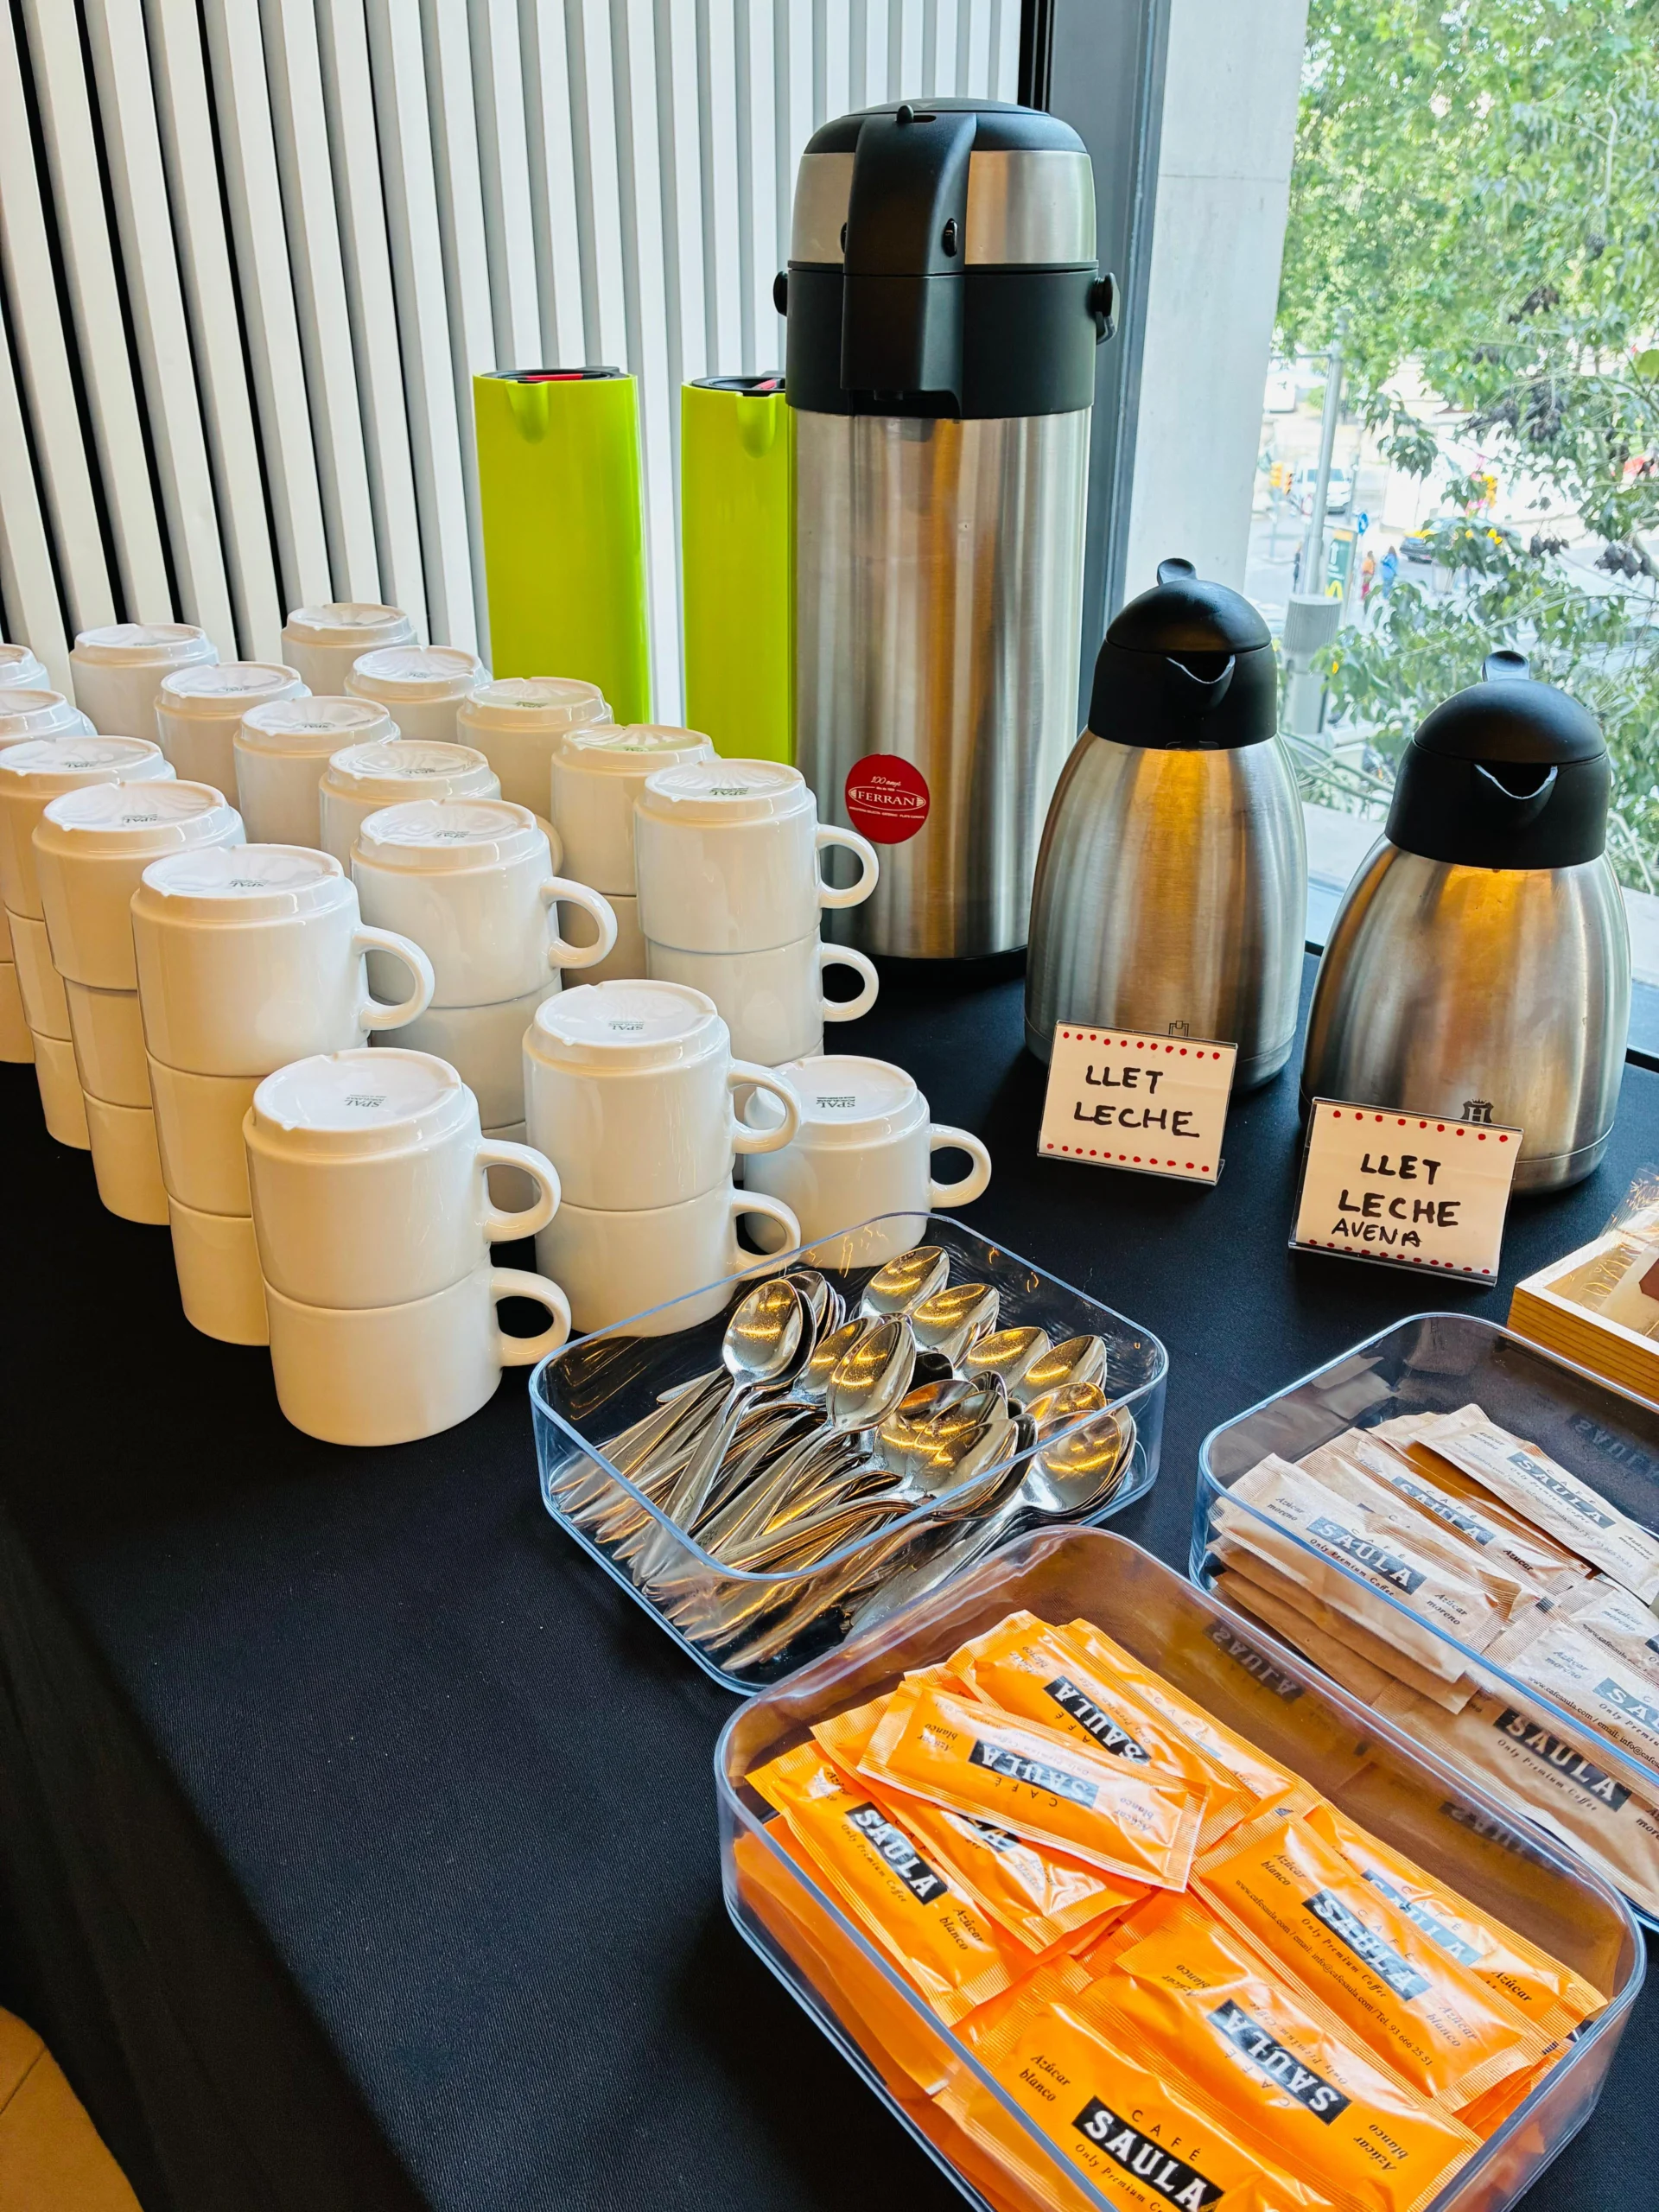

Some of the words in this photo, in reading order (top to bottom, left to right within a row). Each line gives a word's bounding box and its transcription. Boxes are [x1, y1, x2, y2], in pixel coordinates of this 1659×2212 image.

[858, 791, 914, 805] FERRAN
[1085, 1065, 1163, 1094] LLET
[1074, 1102, 1200, 1138] LECHE
[1360, 1154, 1441, 1185] LLET
[1338, 1190, 1460, 1227] LECHE
[1332, 1218, 1422, 1247] AVENA
[1275, 1497, 1305, 1514] Azúcar
[1517, 1459, 1604, 1523] SAULA
[1267, 1503, 1298, 1522] moreno
[1309, 1538, 1329, 1553] Only
[1332, 1550, 1367, 1578] Premium
[1370, 1577, 1395, 1597] Coffee
[1319, 1523, 1413, 1586] SAULA
[1426, 1599, 1461, 1625] moreno
[1434, 1592, 1468, 1617] Azúcar
[1055, 1681, 1143, 1761] SAULA
[1529, 1675, 1593, 1720] www.cafesaula.com
[1599, 1720, 1619, 1739] email:
[1599, 1703, 1622, 1720] Only
[925, 1722, 958, 1741] blanco
[981, 1745, 1090, 1798] SAULA
[1497, 1738, 1520, 1758] Only
[1522, 1757, 1564, 1789] Premium
[1506, 1713, 1616, 1802] SAULA
[994, 1777, 1058, 1807] CAFÉ
[842, 1824, 858, 1842] Only
[857, 1844, 886, 1878] Premium
[887, 1879, 907, 1903] Coffee
[855, 1809, 938, 1897] SAULA
[1274, 1852, 1306, 1878] Azúcar
[1261, 1859, 1291, 1886] blanco
[939, 1916, 969, 1951] blanco
[953, 1907, 984, 1943] Azúcar
[1357, 1910, 1414, 1960] CAFÉ
[1301, 1918, 1322, 1938] Only
[1323, 1936, 1360, 1974] Premium
[1361, 1972, 1388, 1998] Coffee
[1313, 1899, 1416, 1989] SAULA
[1161, 1975, 1199, 1998] Azúcar
[1176, 1964, 1211, 1988] blanco
[1236, 1879, 1291, 1934] www.cafesaula.com
[1293, 1936, 1313, 1955] email:
[1312, 1953, 1374, 2013] info@cafesaula.com
[1376, 2010, 1389, 2027] Tel.
[1389, 2024, 1401, 2036] 93
[1399, 2033, 1413, 2049] 666
[1411, 2046, 1423, 2057] 25
[1421, 2056, 1433, 2066] 51
[1491, 1971, 1533, 2003] Azúcar
[1426, 2014, 1460, 2048] blanco
[1439, 2005, 1478, 2039] Azúcar
[1223, 2009, 1338, 2112] SAULA
[1279, 2027, 1322, 2064] Premium
[1019, 2069, 1057, 2101] blanco
[1031, 2055, 1071, 2087] Azúcar
[1224, 2048, 1291, 2107] CAFÉ
[1131, 2109, 1202, 2161] CAFÉ
[1368, 2124, 1408, 2160] blanco
[1084, 2110, 1208, 2212] SAULA
[1353, 2136, 1397, 2171] Azúcar
[1075, 2144, 1099, 2167] Only
[1101, 2167, 1147, 2203] Premium
